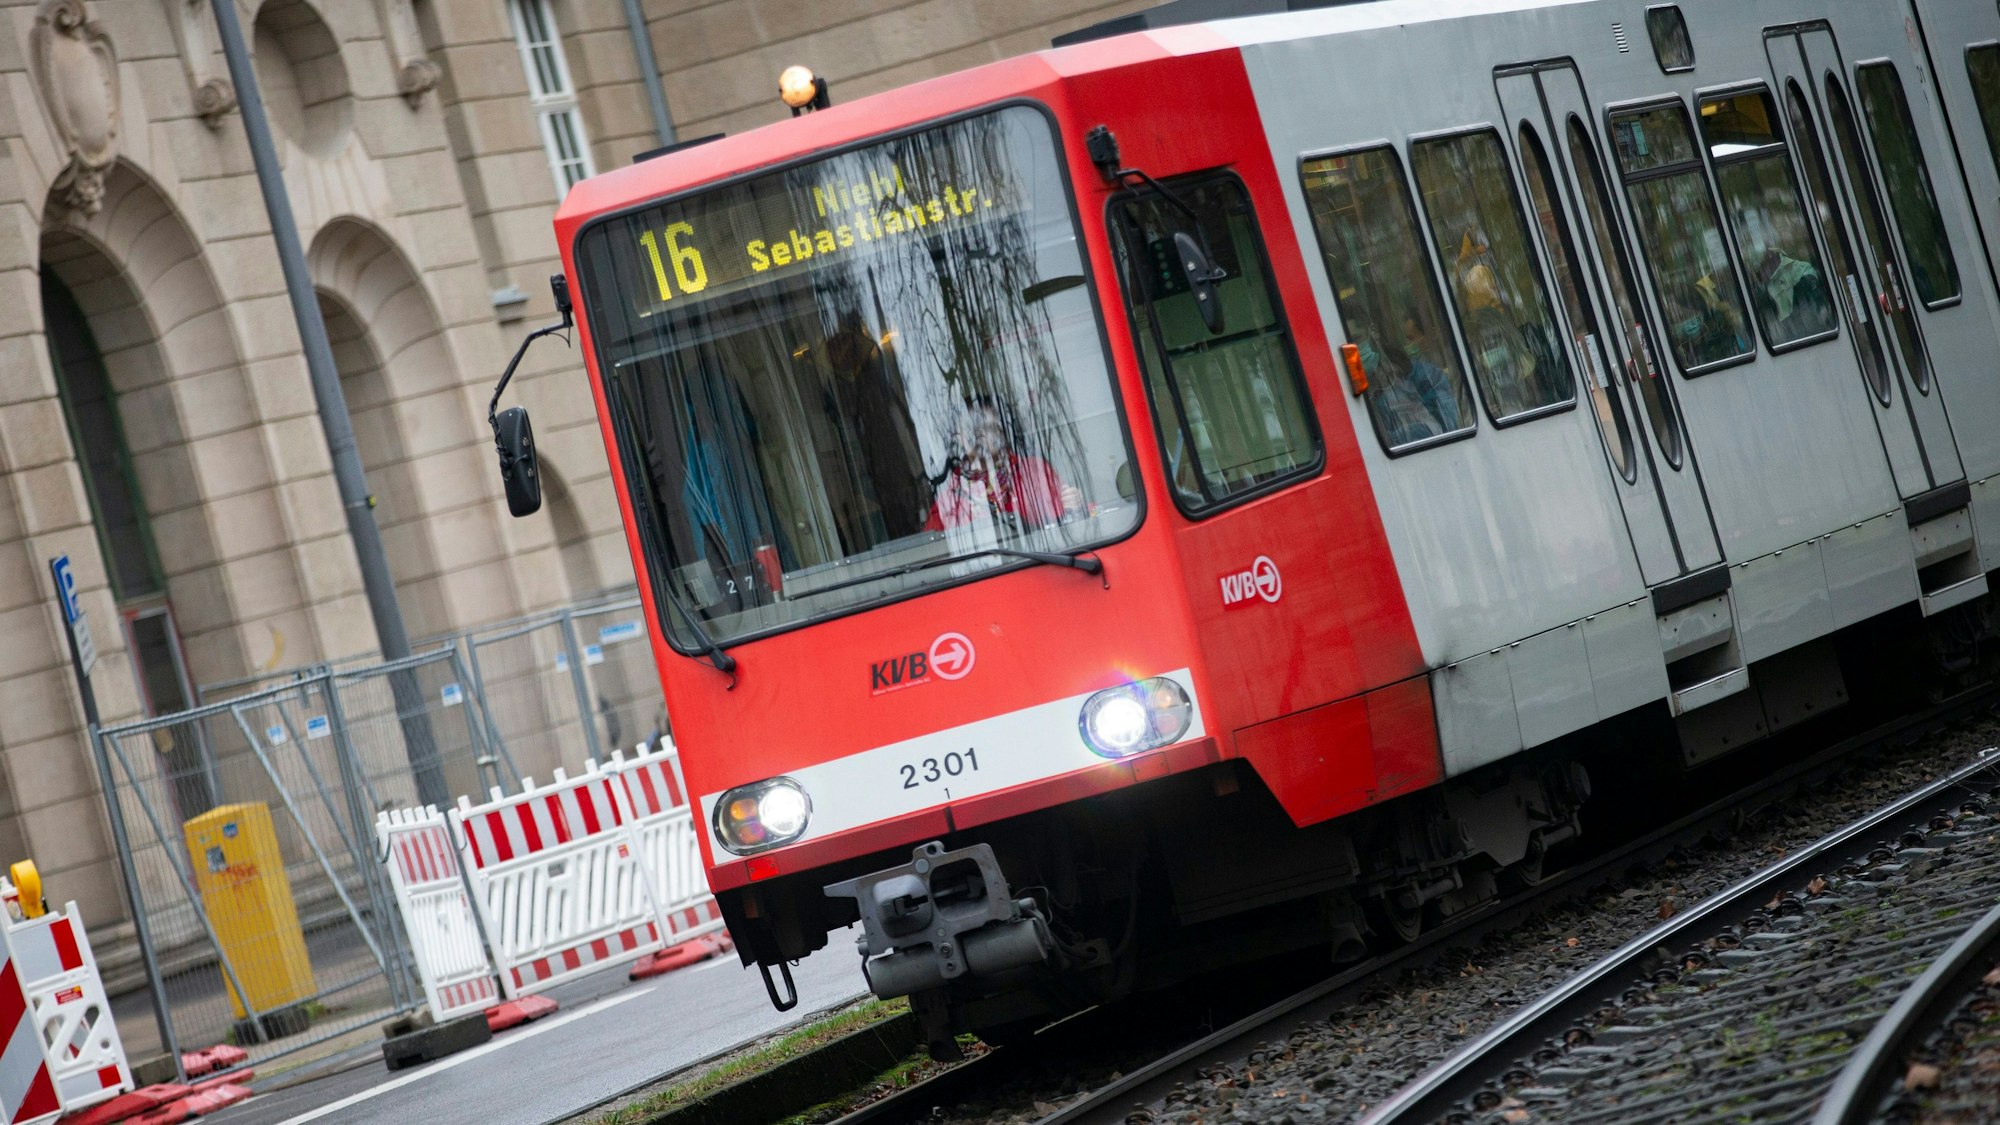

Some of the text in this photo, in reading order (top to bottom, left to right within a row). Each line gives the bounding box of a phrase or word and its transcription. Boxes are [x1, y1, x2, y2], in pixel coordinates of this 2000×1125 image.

[813, 165, 904, 217] Niehl
[746, 186, 992, 272] Sebastianstr.
[639, 221, 708, 301] 16
[1220, 571, 1256, 605] KVB
[872, 652, 928, 690] KVB
[900, 747, 978, 790] 2301
[944, 787, 950, 800] 1
